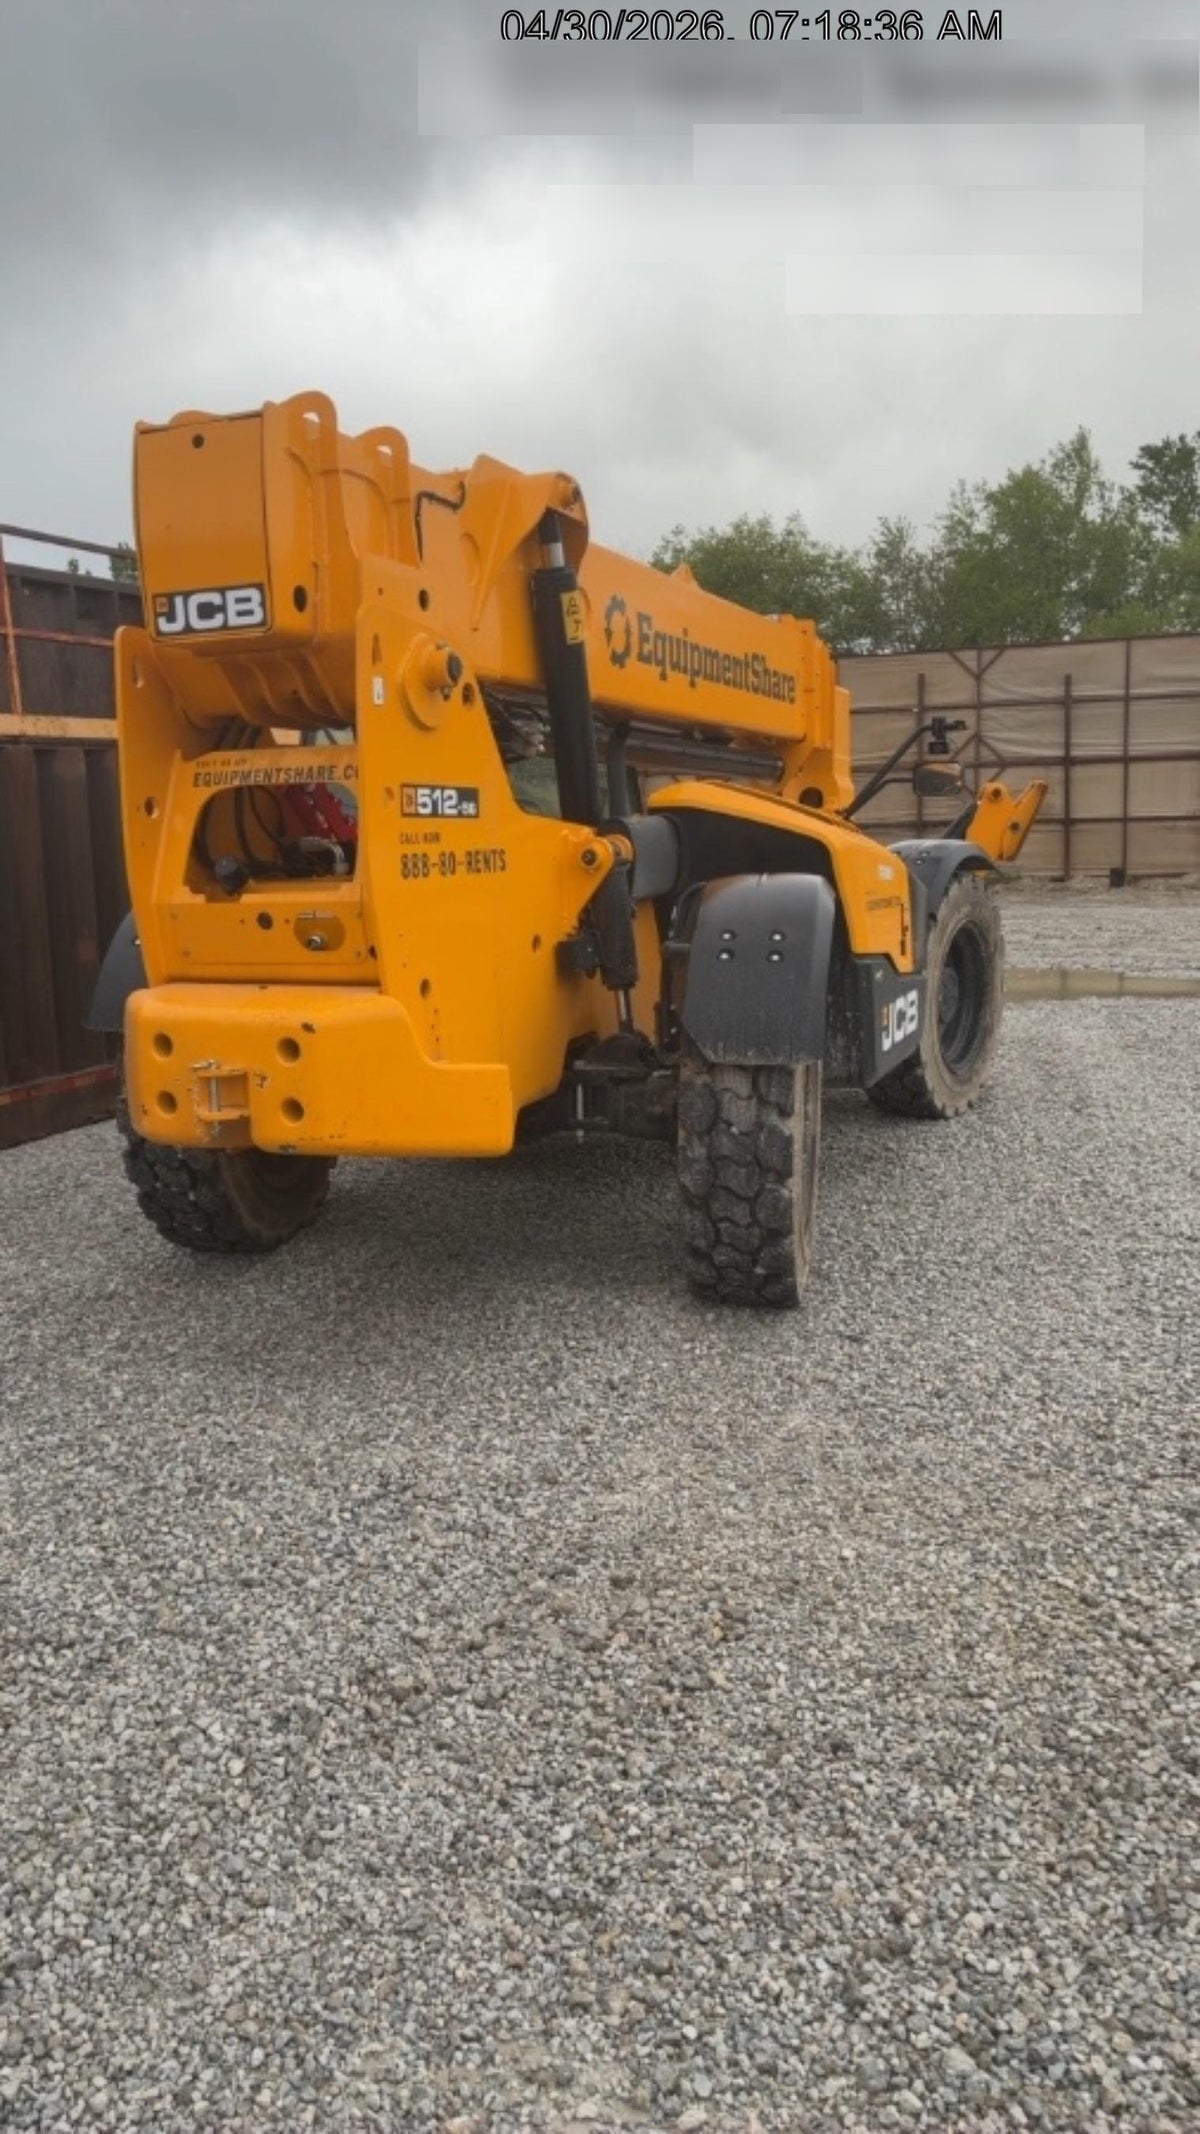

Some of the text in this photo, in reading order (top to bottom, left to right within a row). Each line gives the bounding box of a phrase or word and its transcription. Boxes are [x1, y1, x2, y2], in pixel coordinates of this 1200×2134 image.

[157, 588, 264, 634] JCB
[637, 611, 796, 704] EquipmentShare
[401, 849, 506, 879] 888-80-RENTS
[882, 989, 918, 1051] JCB
